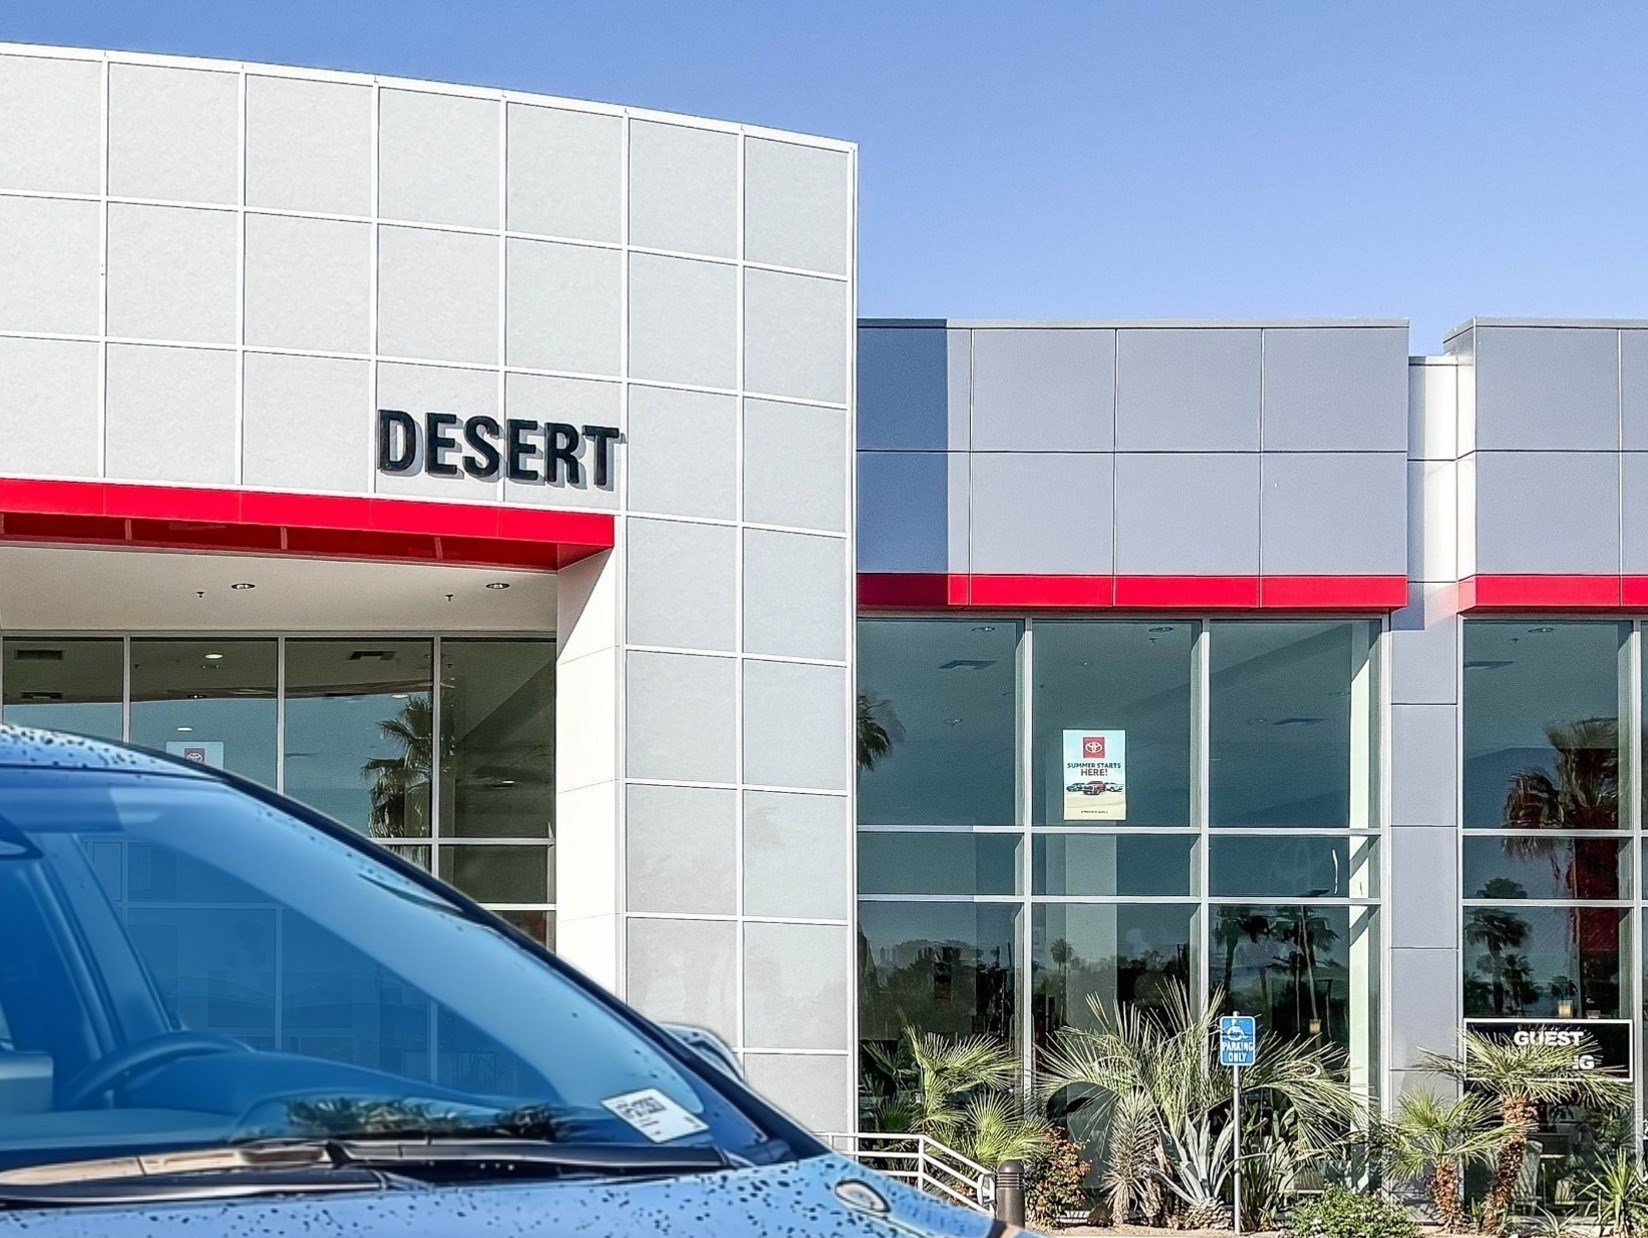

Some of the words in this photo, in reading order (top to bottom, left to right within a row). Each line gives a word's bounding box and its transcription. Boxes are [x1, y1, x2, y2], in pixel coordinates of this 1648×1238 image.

[377, 409, 620, 487] DESERT
[1080, 768, 1108, 777] HERE!
[1513, 1031, 1585, 1047] GUEST
[1222, 1041, 1254, 1052] PARKING
[1228, 1051, 1248, 1063] ONLY
